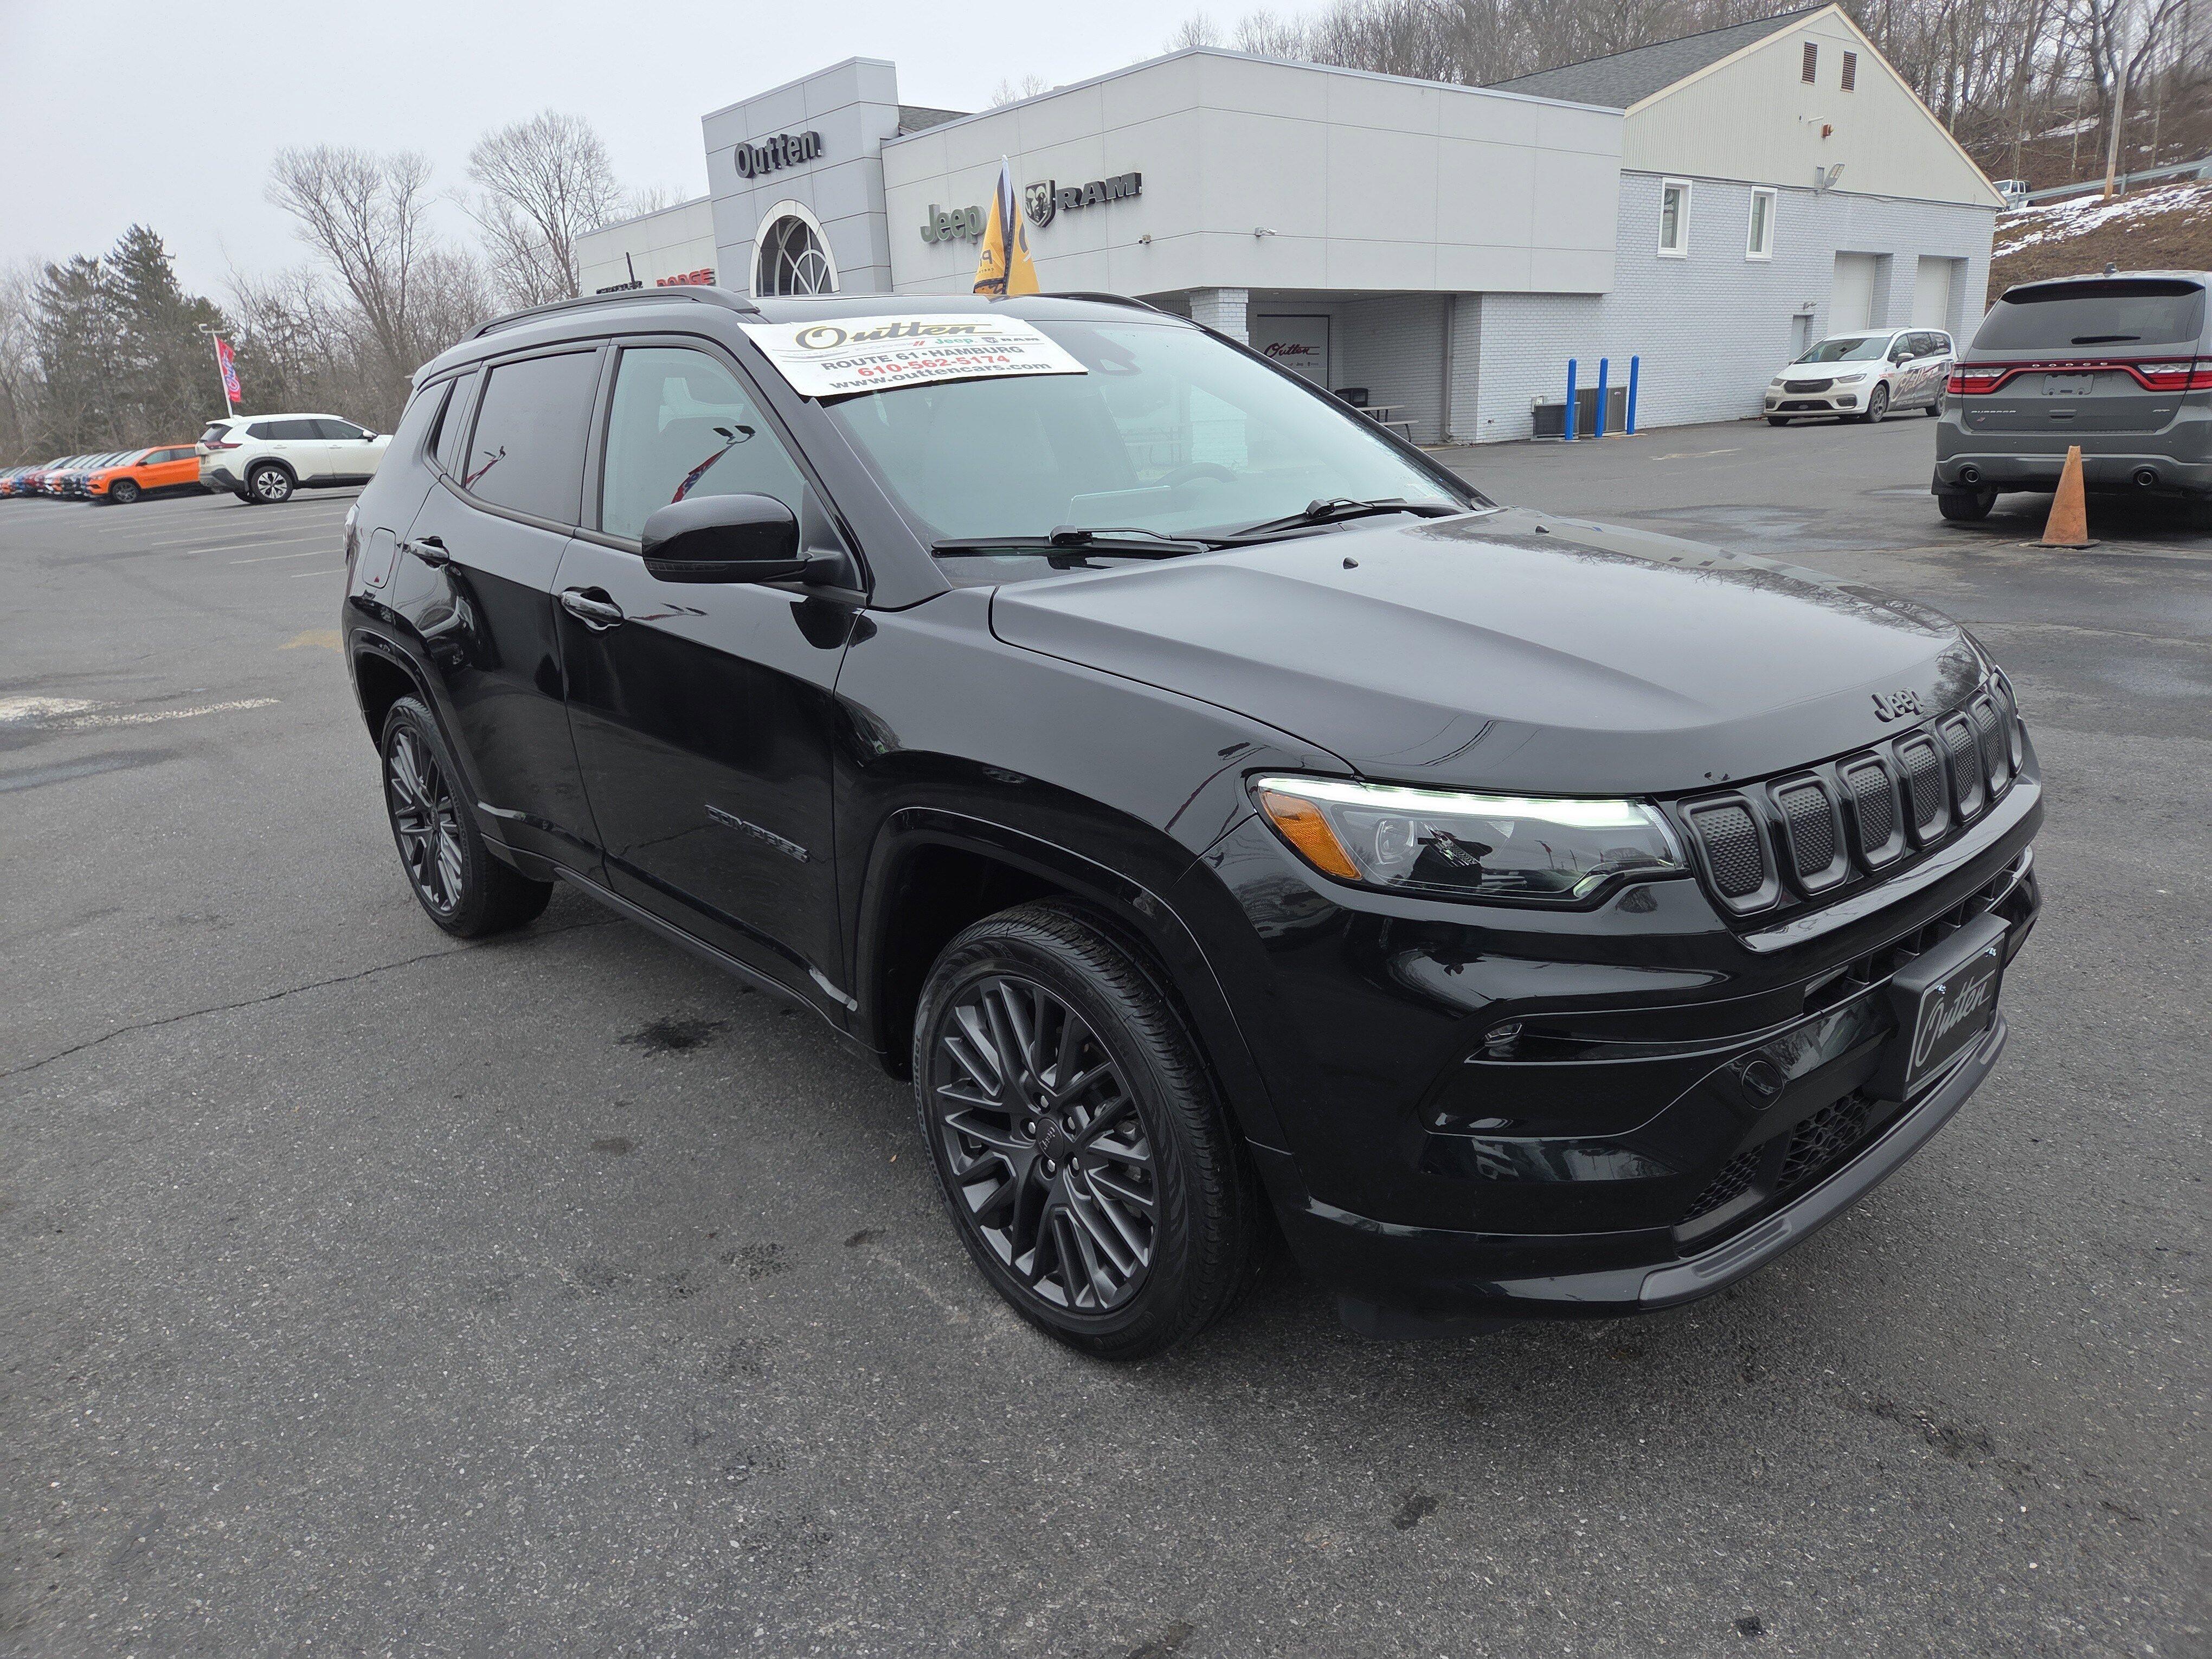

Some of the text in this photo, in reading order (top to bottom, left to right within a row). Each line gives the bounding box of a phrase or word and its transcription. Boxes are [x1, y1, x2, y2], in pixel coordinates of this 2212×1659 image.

[735, 131, 821, 178] Outten
[1056, 172, 1142, 210] RAM
[920, 204, 986, 244] Jeep
[656, 268, 716, 287] DODGE
[795, 321, 1004, 350] Outten
[820, 355, 893, 370] ROUTE
[1264, 343, 1320, 358] Outten
[829, 363, 1052, 389] www.outtencars.com
[858, 355, 1011, 376] 610-562-5174
[1872, 687, 1925, 723] Jeep
[1915, 969, 1996, 1067] Outten
